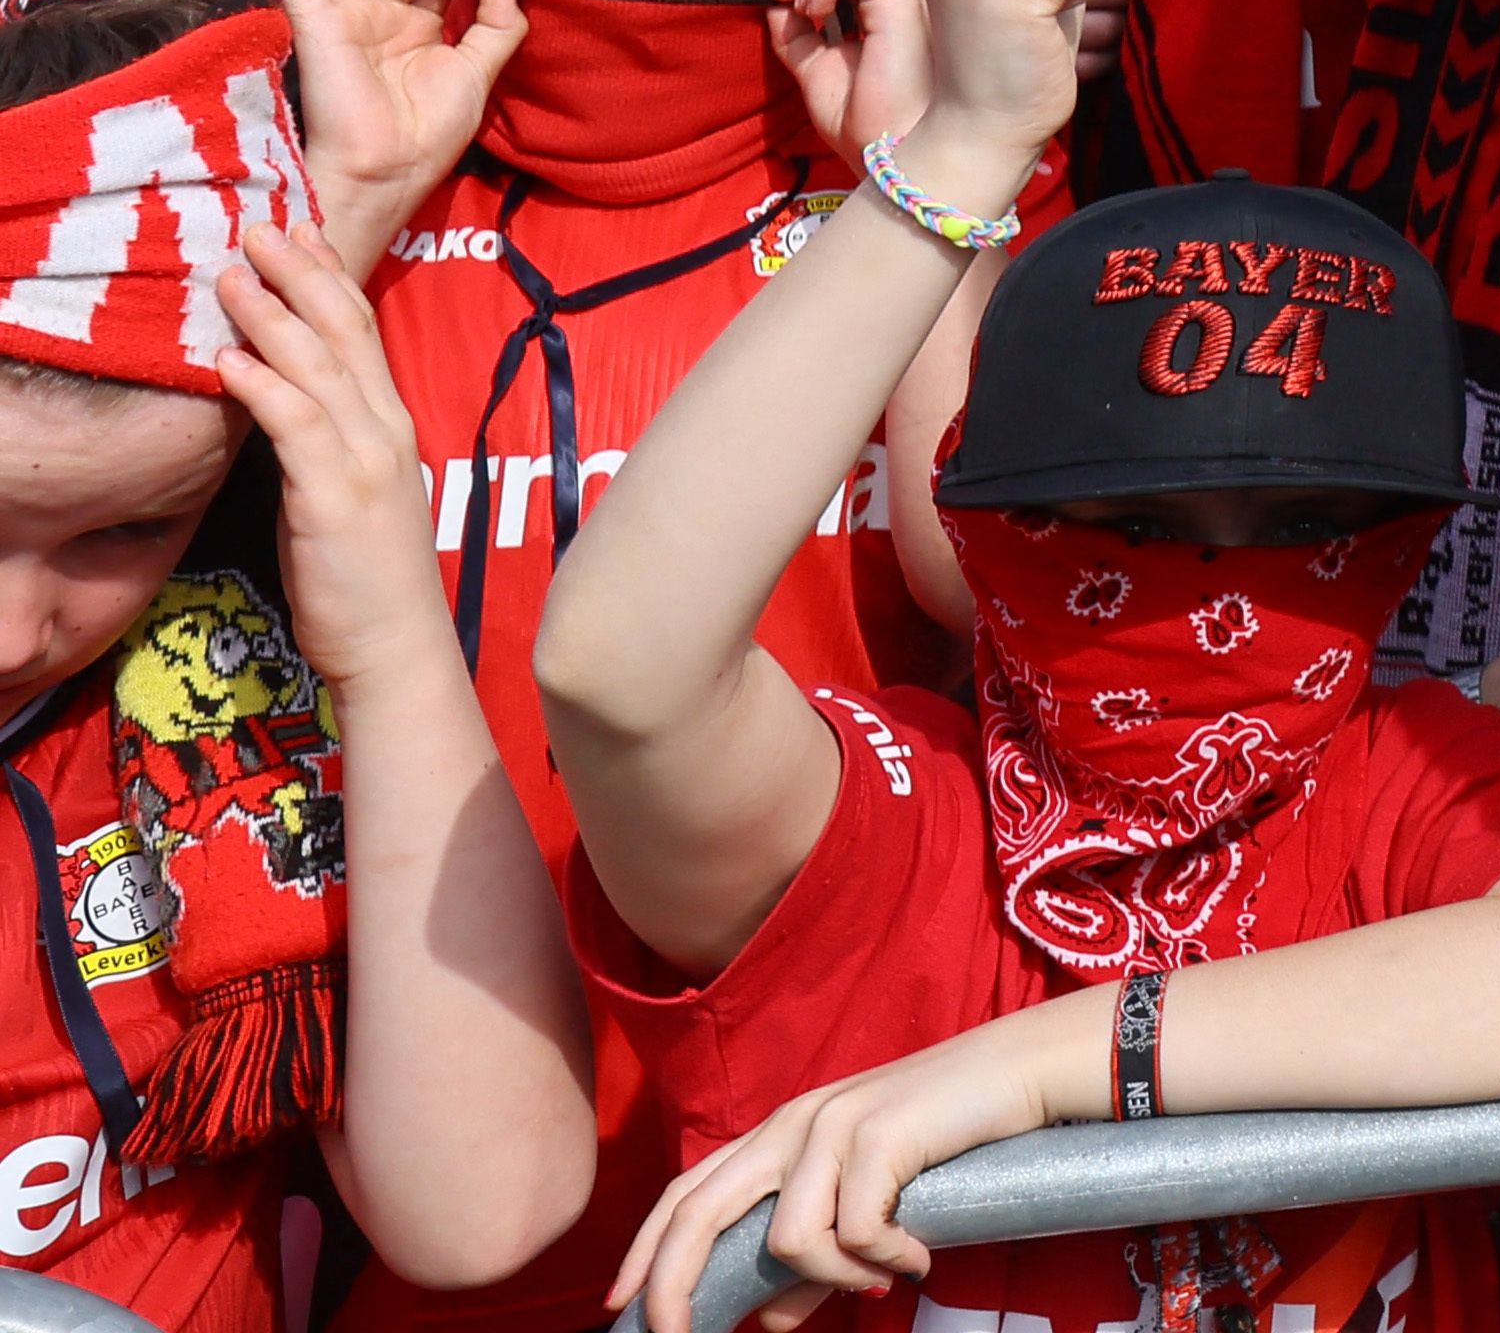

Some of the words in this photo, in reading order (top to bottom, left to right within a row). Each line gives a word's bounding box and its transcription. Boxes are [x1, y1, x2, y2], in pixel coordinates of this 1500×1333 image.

[388, 226, 504, 263] JAKO
[1092, 240, 1399, 317] BAYER
[1139, 298, 1330, 399] 04
[92, 881, 156, 919] BAYE
